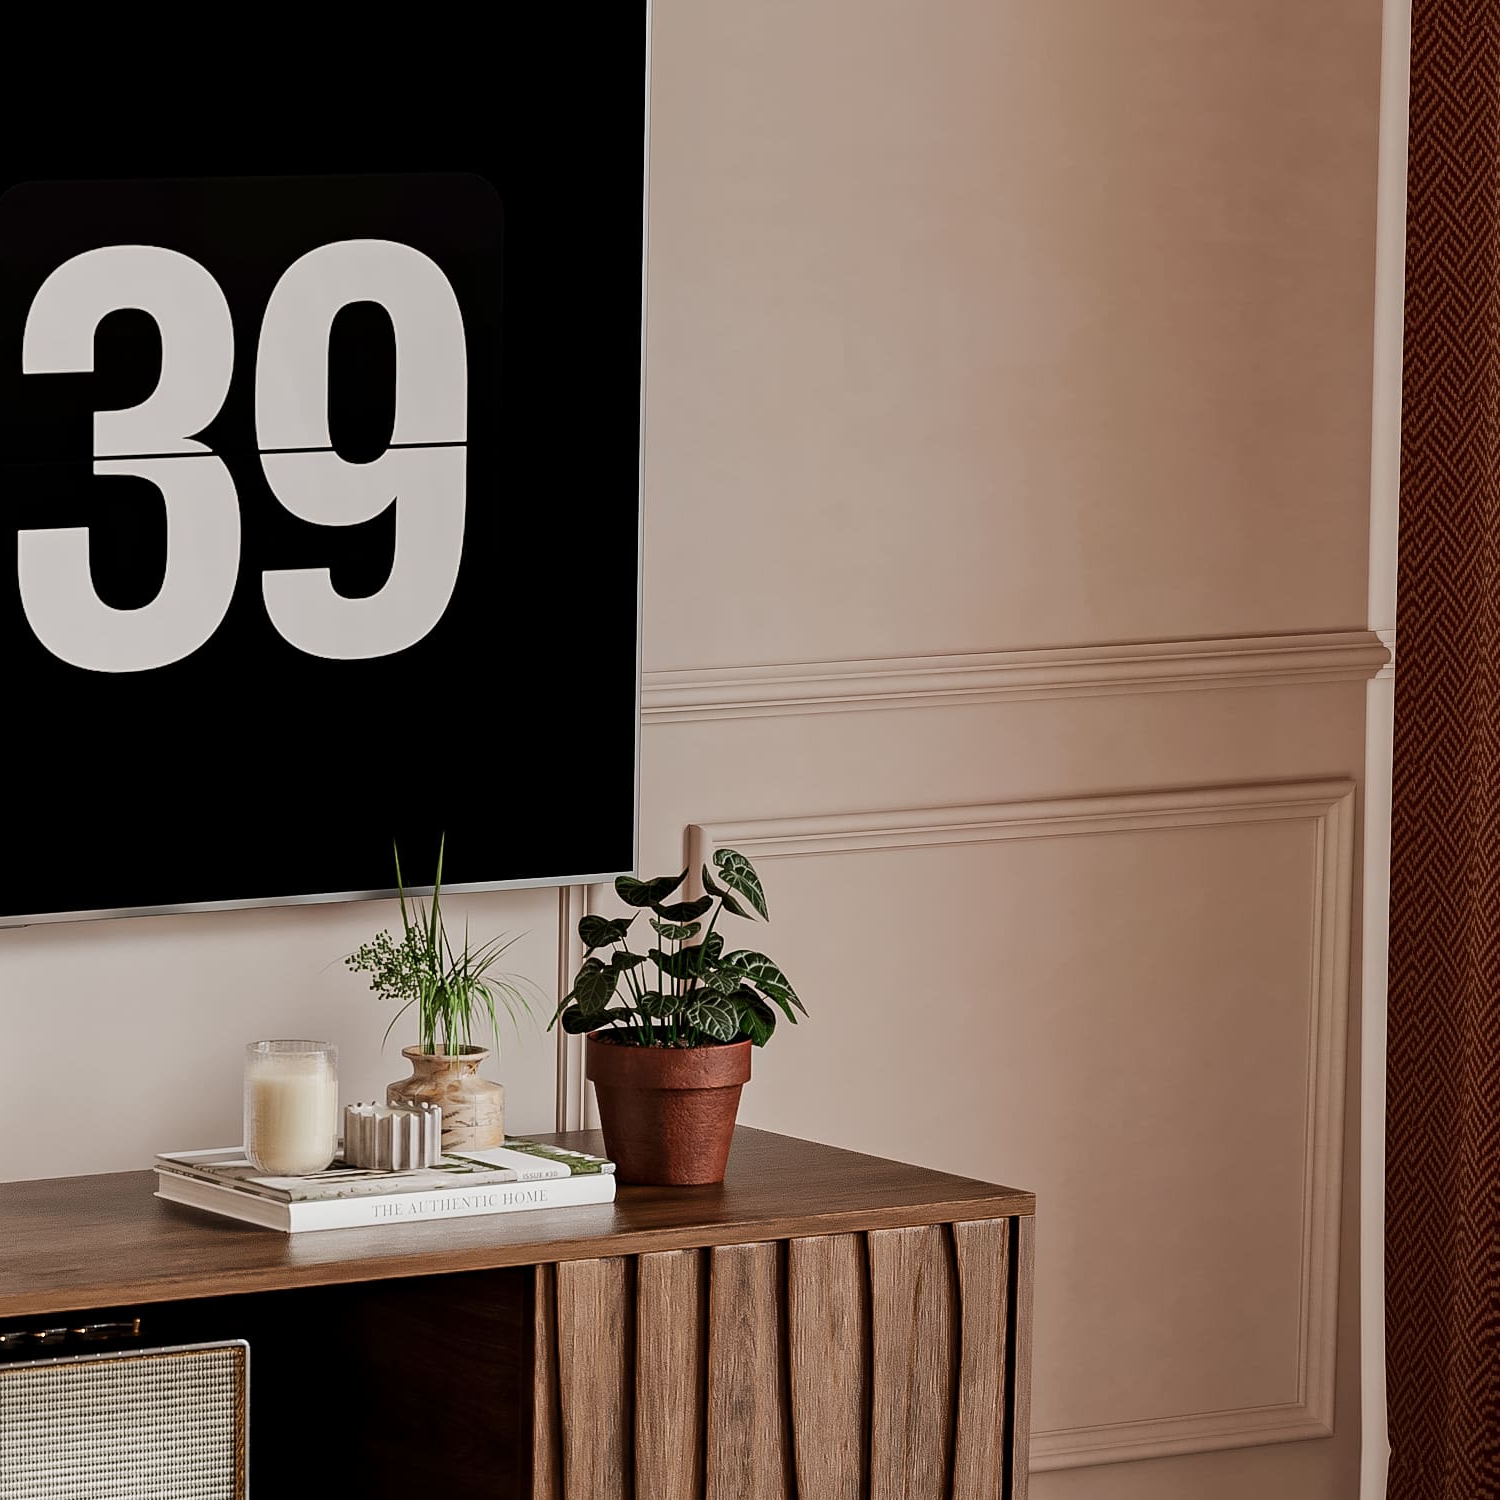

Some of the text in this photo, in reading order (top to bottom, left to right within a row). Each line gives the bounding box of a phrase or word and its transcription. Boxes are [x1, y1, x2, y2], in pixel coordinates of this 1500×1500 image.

[17, 238, 468, 674] 39
[372, 1190, 549, 1218] THE AUTHENTIC HOME
